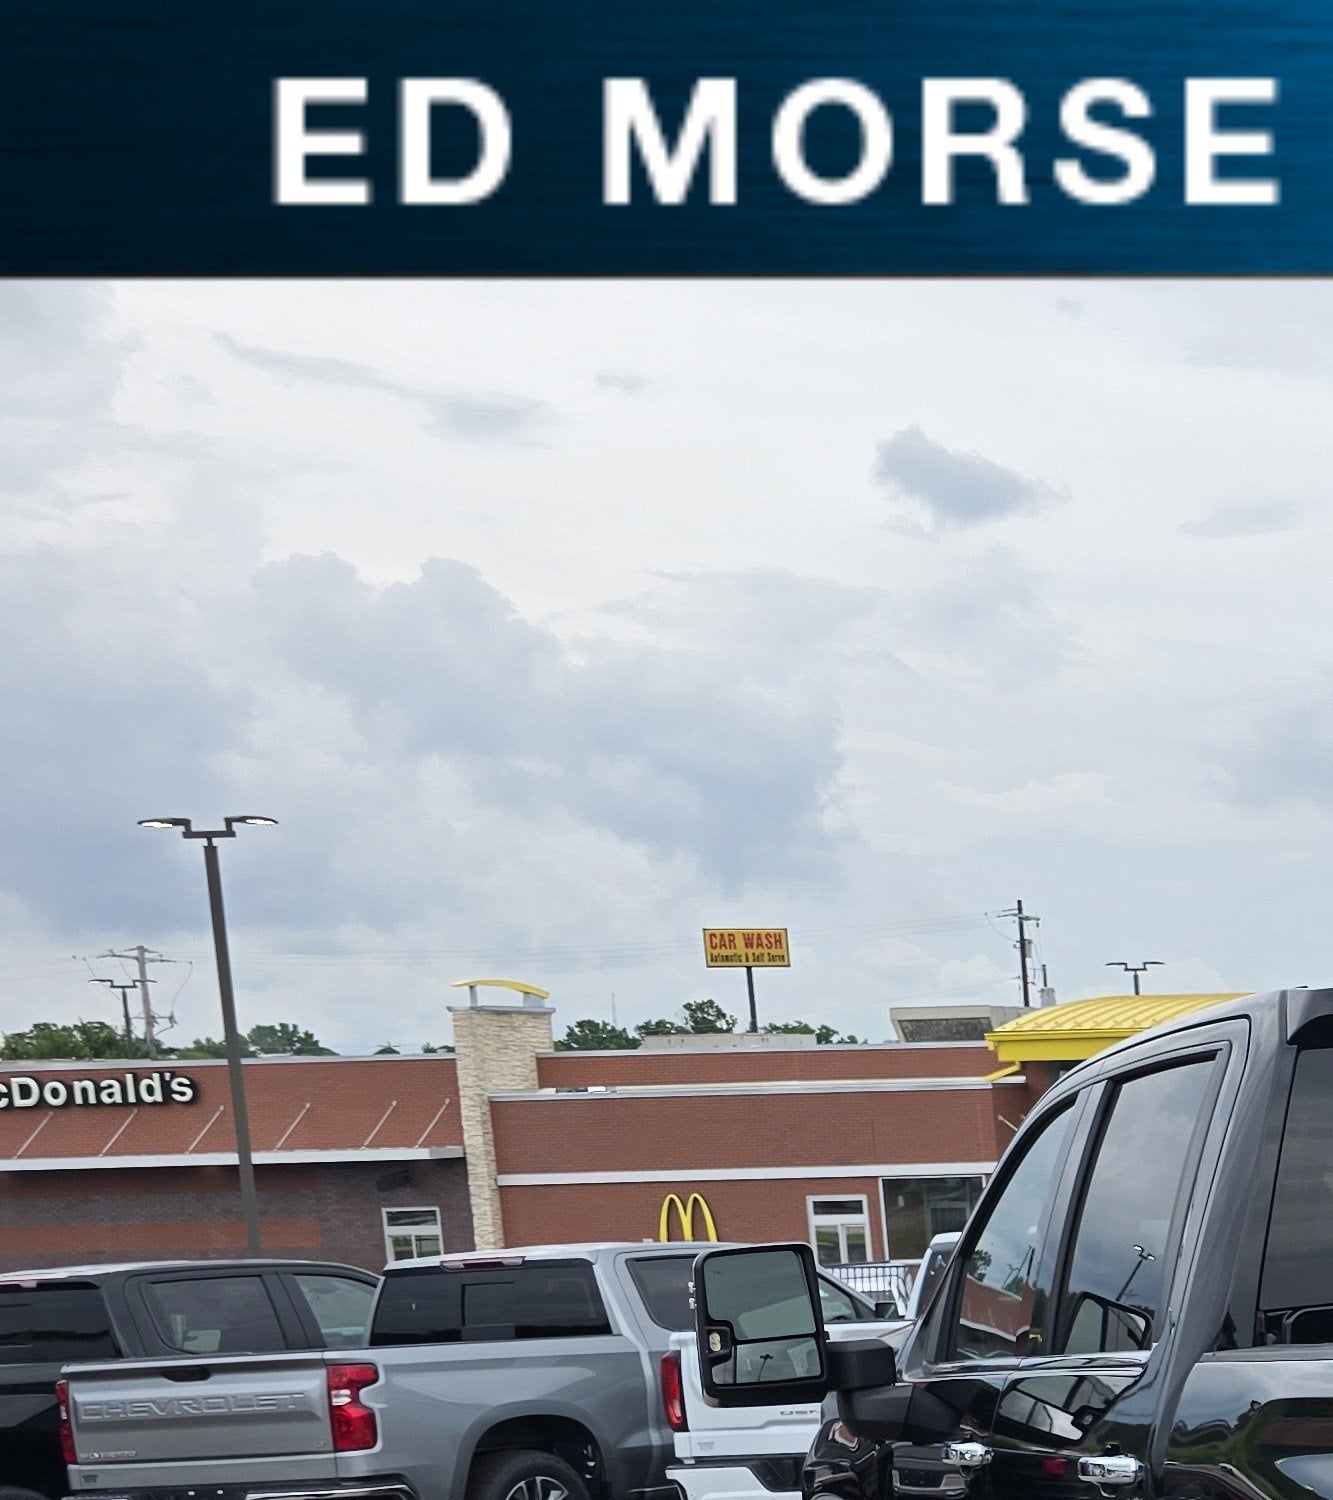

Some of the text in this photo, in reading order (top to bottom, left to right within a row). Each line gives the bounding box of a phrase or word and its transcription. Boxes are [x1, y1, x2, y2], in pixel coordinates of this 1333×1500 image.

[709, 932, 783, 950] CAR WASH
[80, 1391, 304, 1422] CHEVROLET
